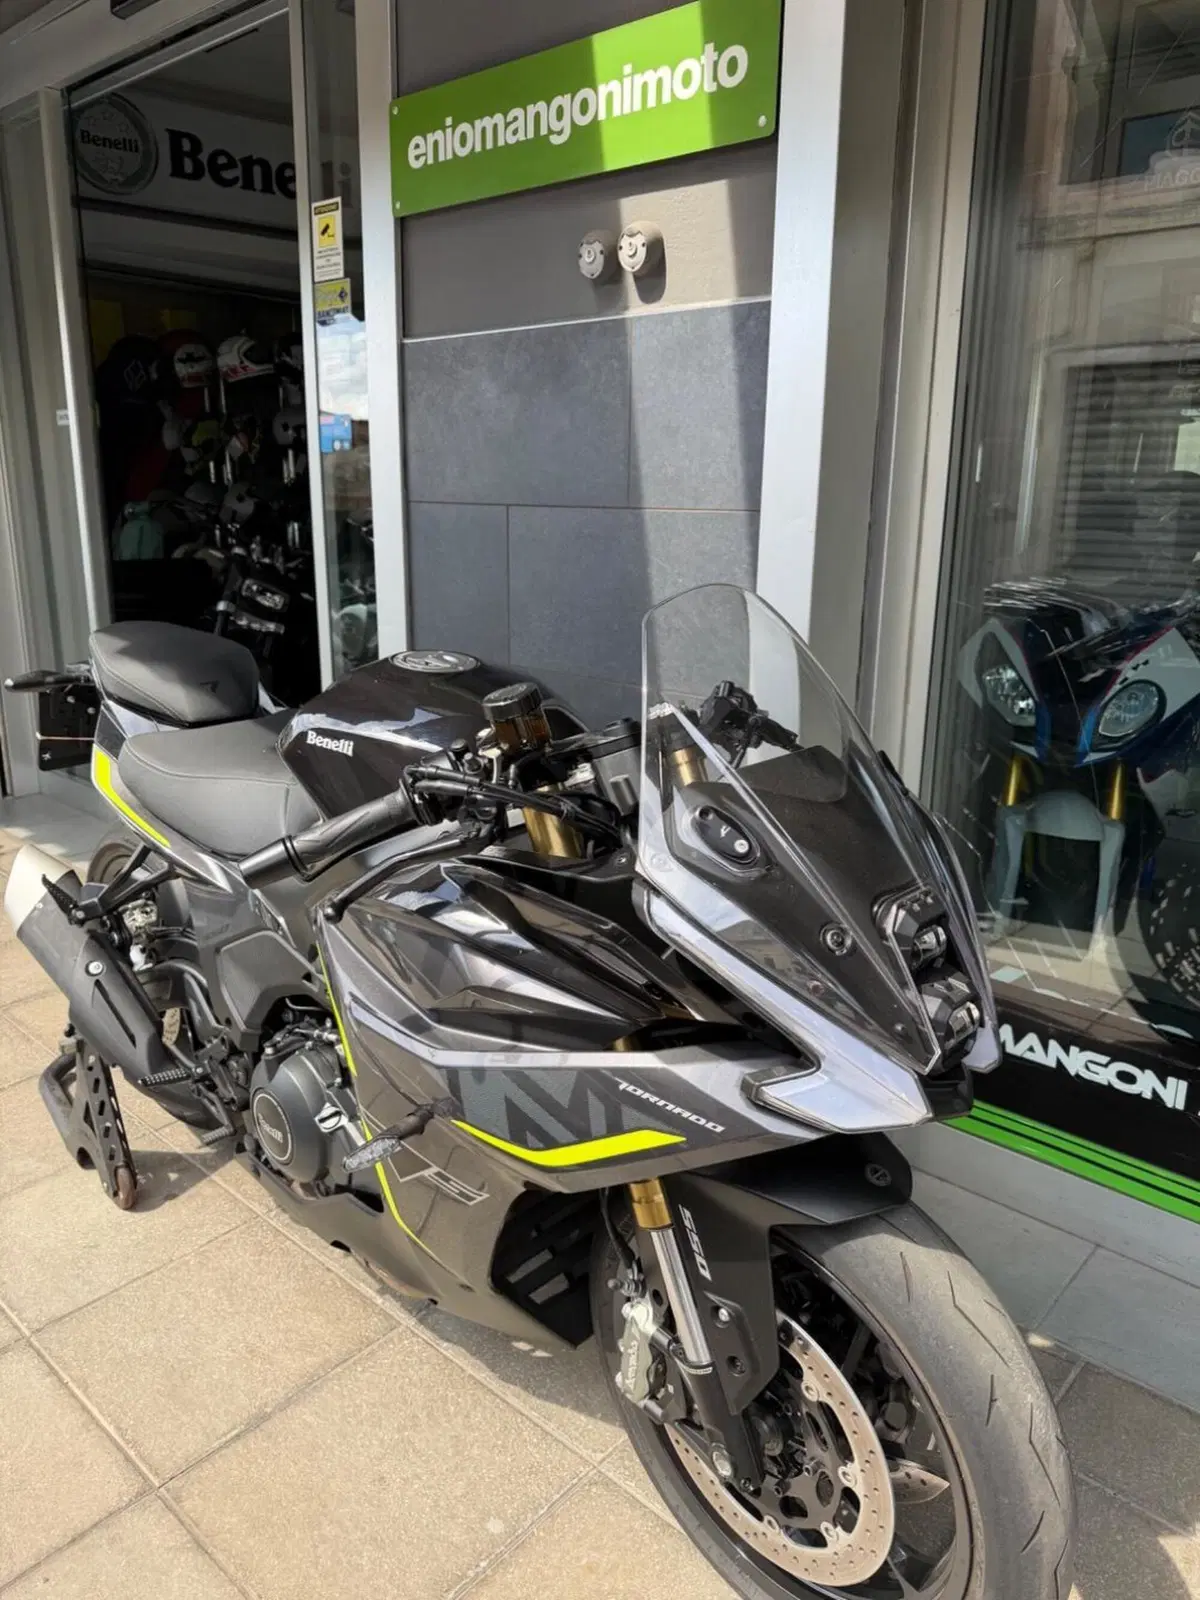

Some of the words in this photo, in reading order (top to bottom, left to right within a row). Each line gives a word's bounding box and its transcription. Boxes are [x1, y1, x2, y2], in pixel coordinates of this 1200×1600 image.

[406, 41, 749, 170] eniomangonimoto
[79, 128, 140, 154] Benelli
[306, 729, 355, 758] Benelli
[614, 1077, 726, 1133] TORNADO
